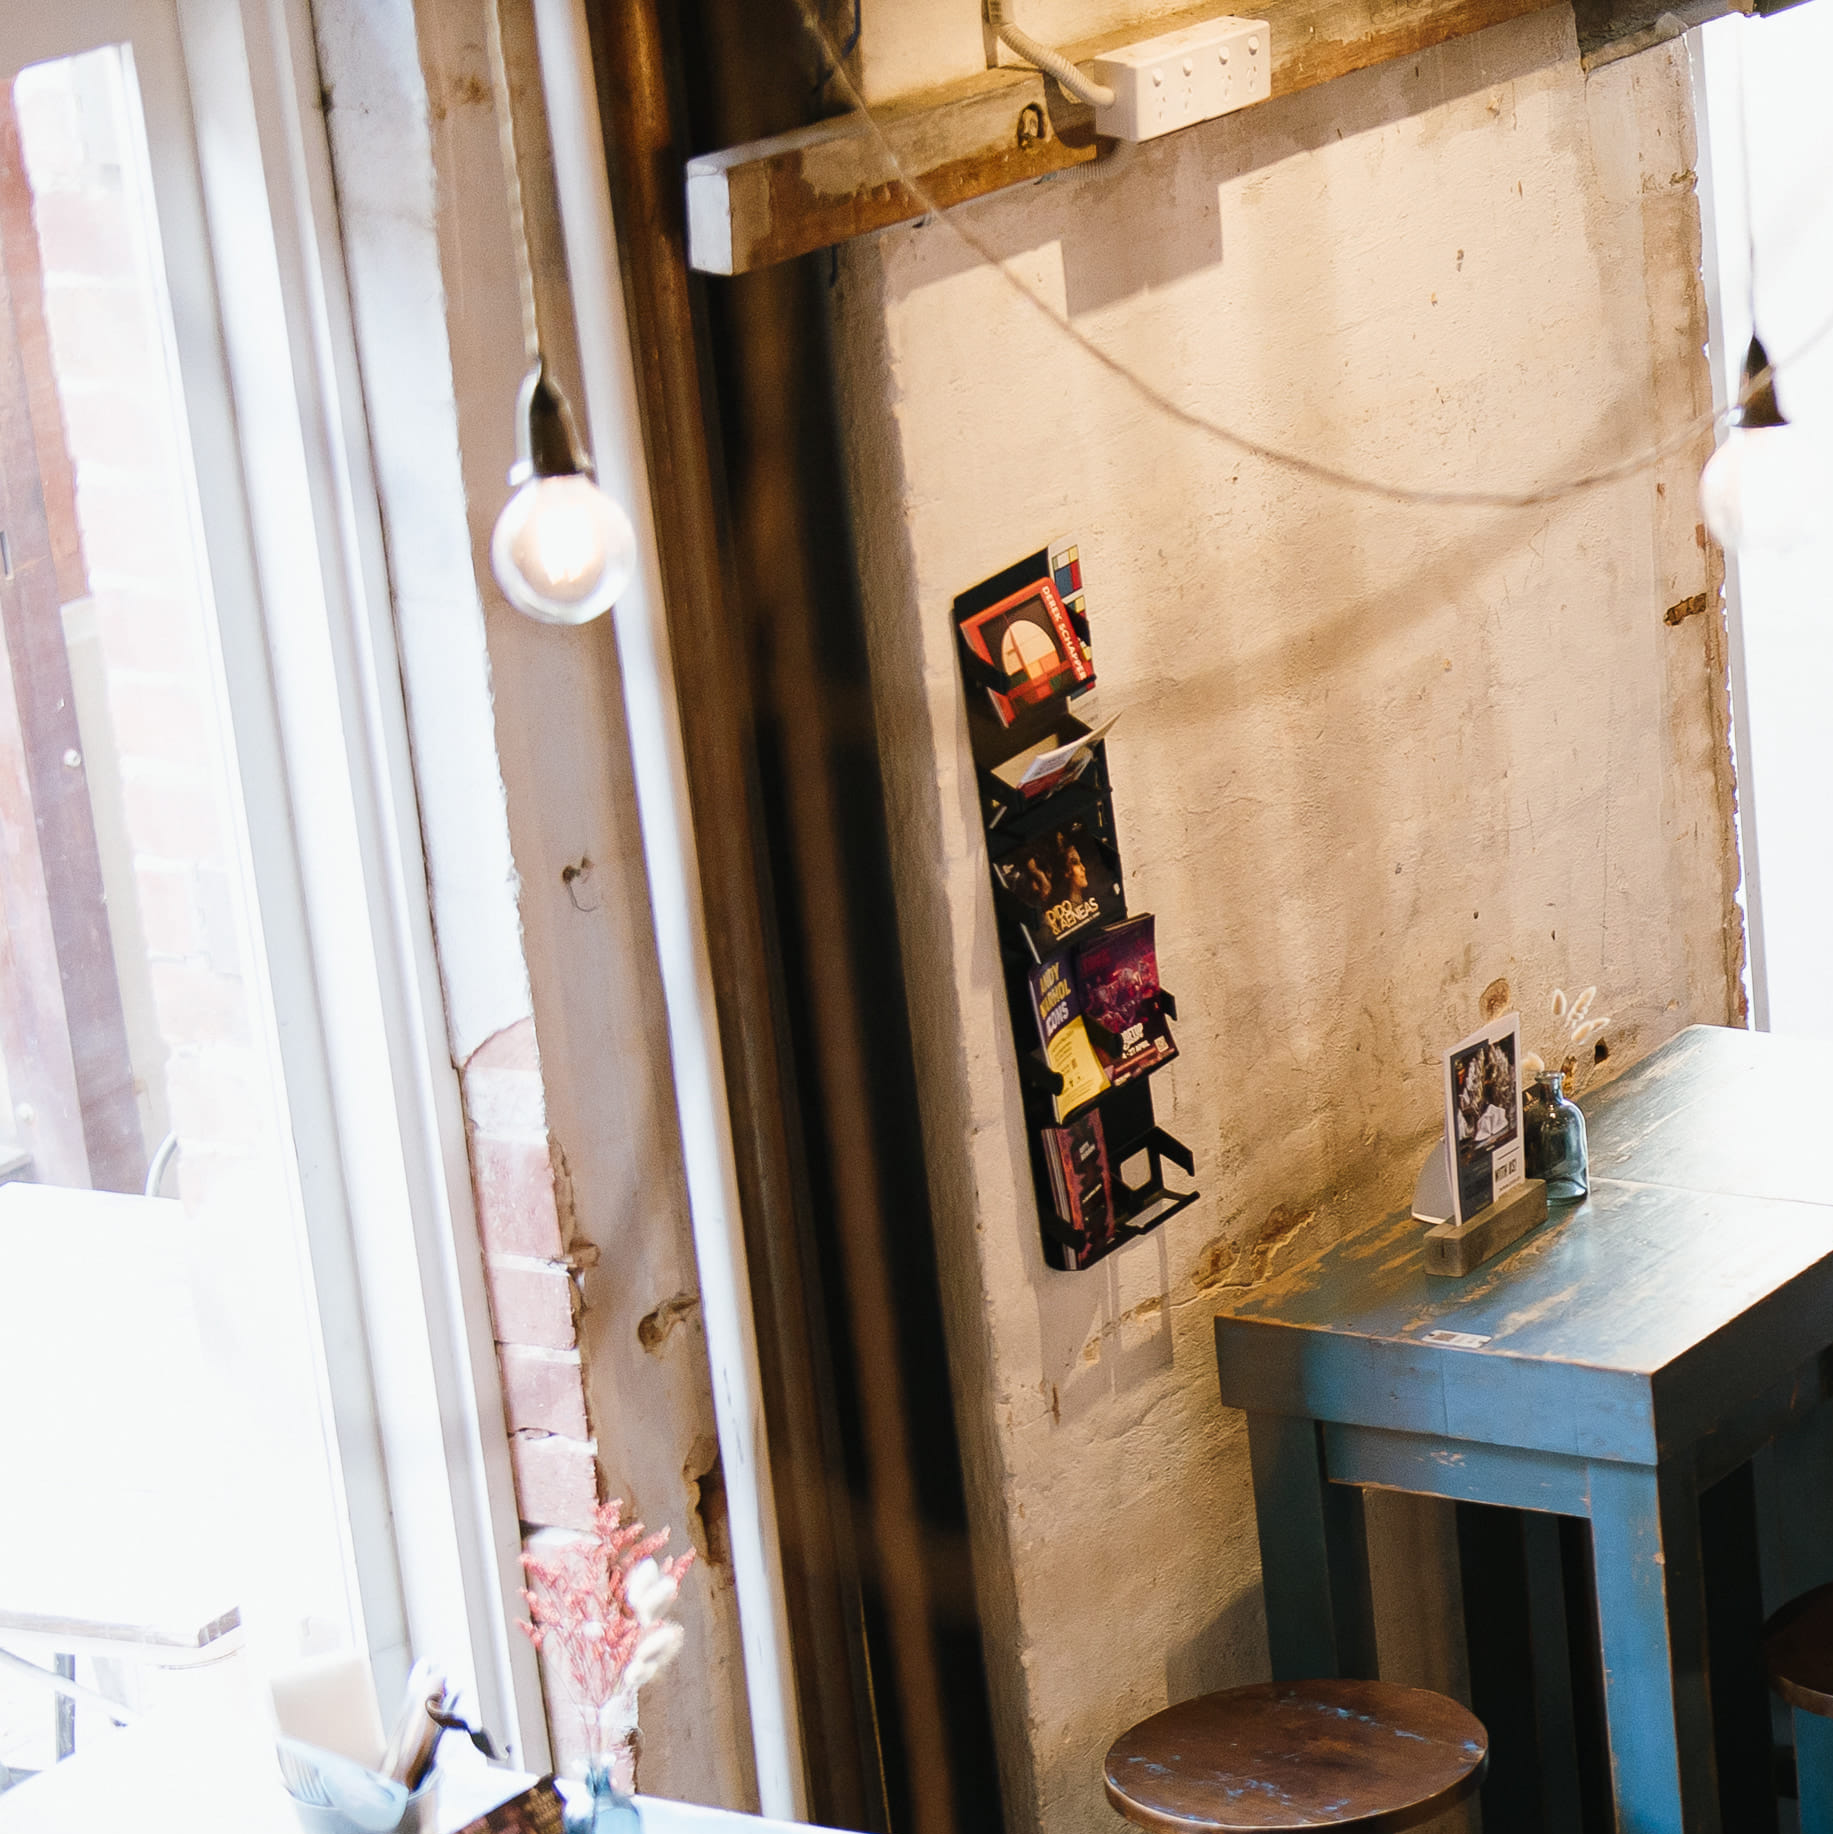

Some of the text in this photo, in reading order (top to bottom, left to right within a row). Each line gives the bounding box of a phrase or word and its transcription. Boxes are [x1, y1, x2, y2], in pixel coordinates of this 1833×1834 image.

[1041, 586, 1062, 621] DEREK
[1045, 900, 1072, 924] DIDO
[1060, 897, 1099, 930] AENEAS
